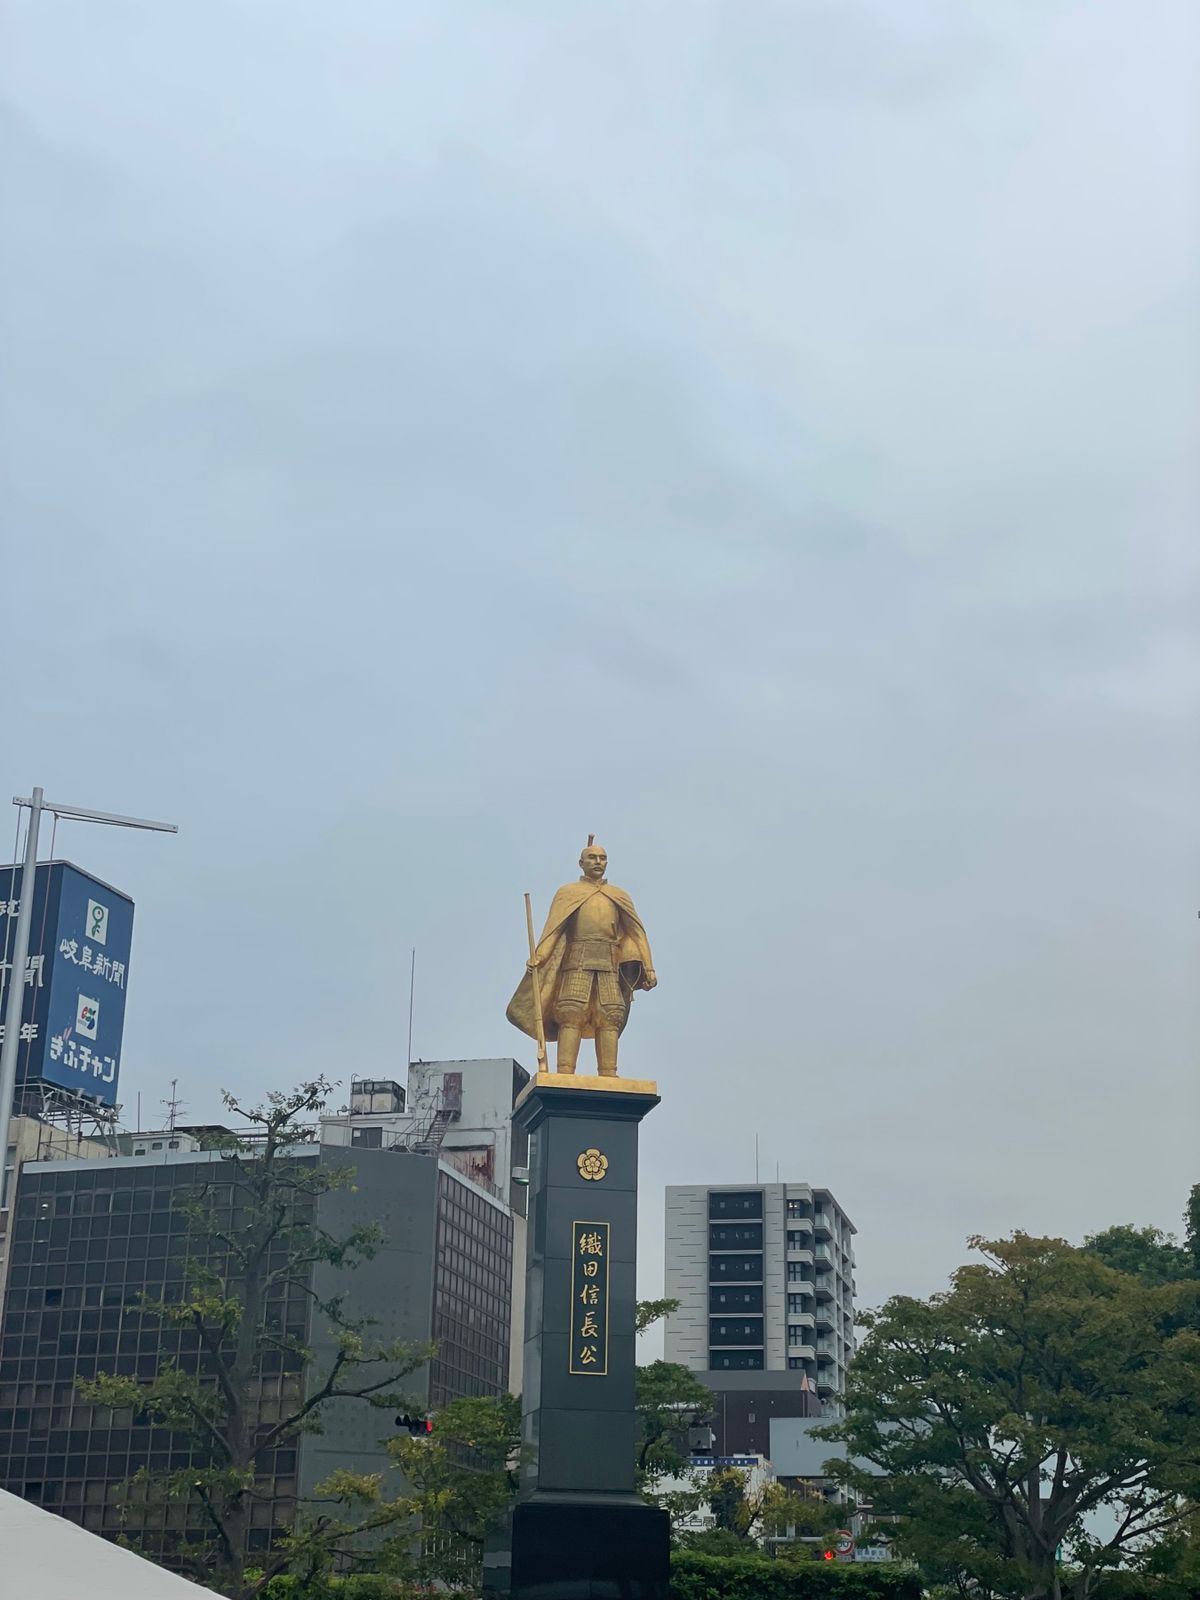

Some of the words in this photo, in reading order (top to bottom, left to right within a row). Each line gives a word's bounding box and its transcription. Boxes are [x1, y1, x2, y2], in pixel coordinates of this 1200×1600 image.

[59, 938, 126, 989] 岐阜新聞
[50, 1027, 116, 1083] ぎふチャン
[579, 1231, 603, 1365] 織田信長公
